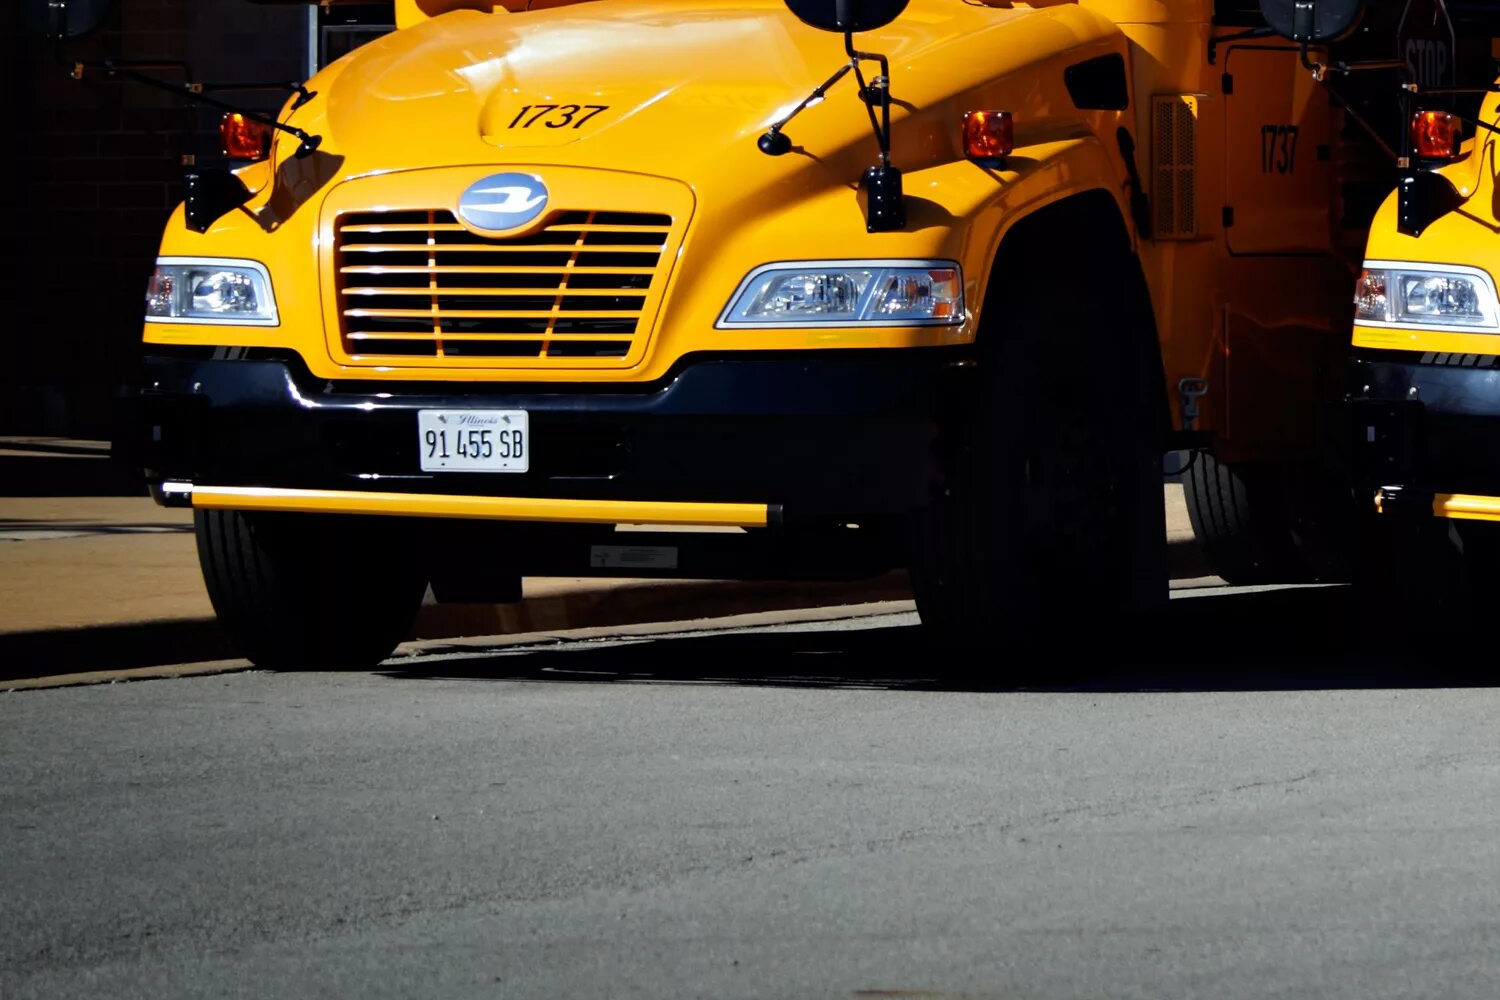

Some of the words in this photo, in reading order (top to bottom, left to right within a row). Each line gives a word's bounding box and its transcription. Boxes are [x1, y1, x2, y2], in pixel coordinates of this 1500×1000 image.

[1404, 37, 1449, 88] STOP
[508, 104, 609, 130] 1737
[1261, 124, 1299, 173] 1737
[458, 414, 498, 425] Illinois
[425, 430, 450, 458] 91
[457, 430, 492, 458] 455
[499, 430, 523, 458] SB
